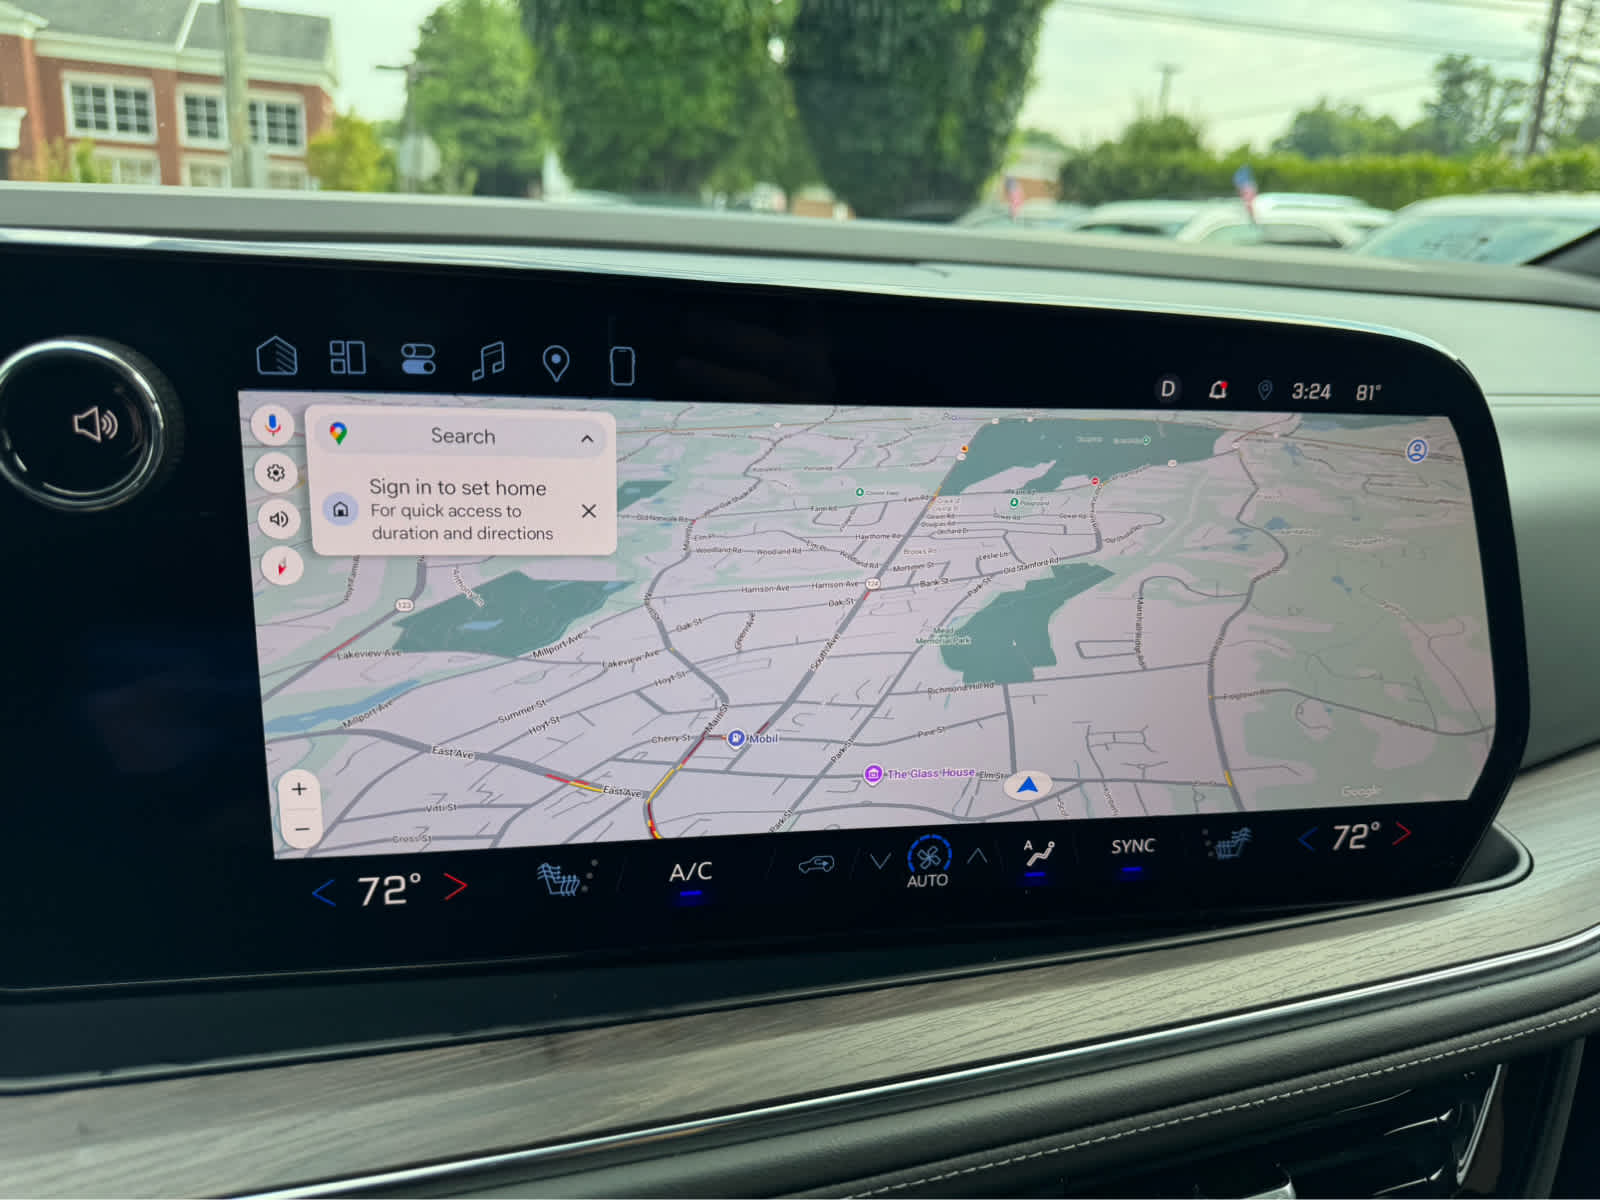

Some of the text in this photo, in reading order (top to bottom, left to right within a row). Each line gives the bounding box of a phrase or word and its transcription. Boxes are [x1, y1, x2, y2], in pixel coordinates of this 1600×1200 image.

[1162, 381, 1175, 397] D
[1292, 383, 1331, 400] 3:24
[1356, 384, 1382, 401] 81°
[431, 427, 496, 446] Search
[370, 478, 547, 499] Sign in to set home
[371, 503, 522, 521] For quick access to
[372, 526, 554, 542] duration and directions
[1003, 557, 1059, 575] Old Stamford Rd
[844, 580, 858, 588] Ave
[919, 577, 949, 588] Bank St
[967, 583, 982, 597] Park
[829, 597, 855, 608] Oak St
[676, 617, 703, 632] Oak St
[532, 632, 585, 659] Millport Ave
[953, 637, 971, 645] Park
[337, 649, 402, 661] Lakeview Ave
[810, 633, 841, 670] South Ave
[602, 650, 660, 671] Lakeview Ave
[654, 671, 687, 687] Hoyt St
[927, 686, 964, 695] Richmond
[342, 701, 394, 729] Millport Ave
[497, 699, 547, 723] Summer St
[705, 703, 729, 732] Main St
[528, 716, 561, 735] Hoyt St
[651, 734, 691, 745] Cherry St
[749, 734, 778, 744] Mobil
[431, 745, 475, 760] East Ave
[831, 746, 845, 763] Park
[888, 768, 975, 779] The Glass House
[979, 771, 993, 779] Elm
[603, 785, 642, 799] East Ave
[1342, 784, 1381, 799] Google
[447, 804, 457, 812] St
[783, 808, 793, 819] St
[391, 835, 432, 843] Cross St
[1333, 820, 1381, 851] 72°
[1024, 840, 1032, 851] A
[1112, 838, 1156, 855] SYNC
[669, 861, 713, 882] A/C
[907, 873, 949, 888] AUTO
[358, 872, 421, 906] 72°
